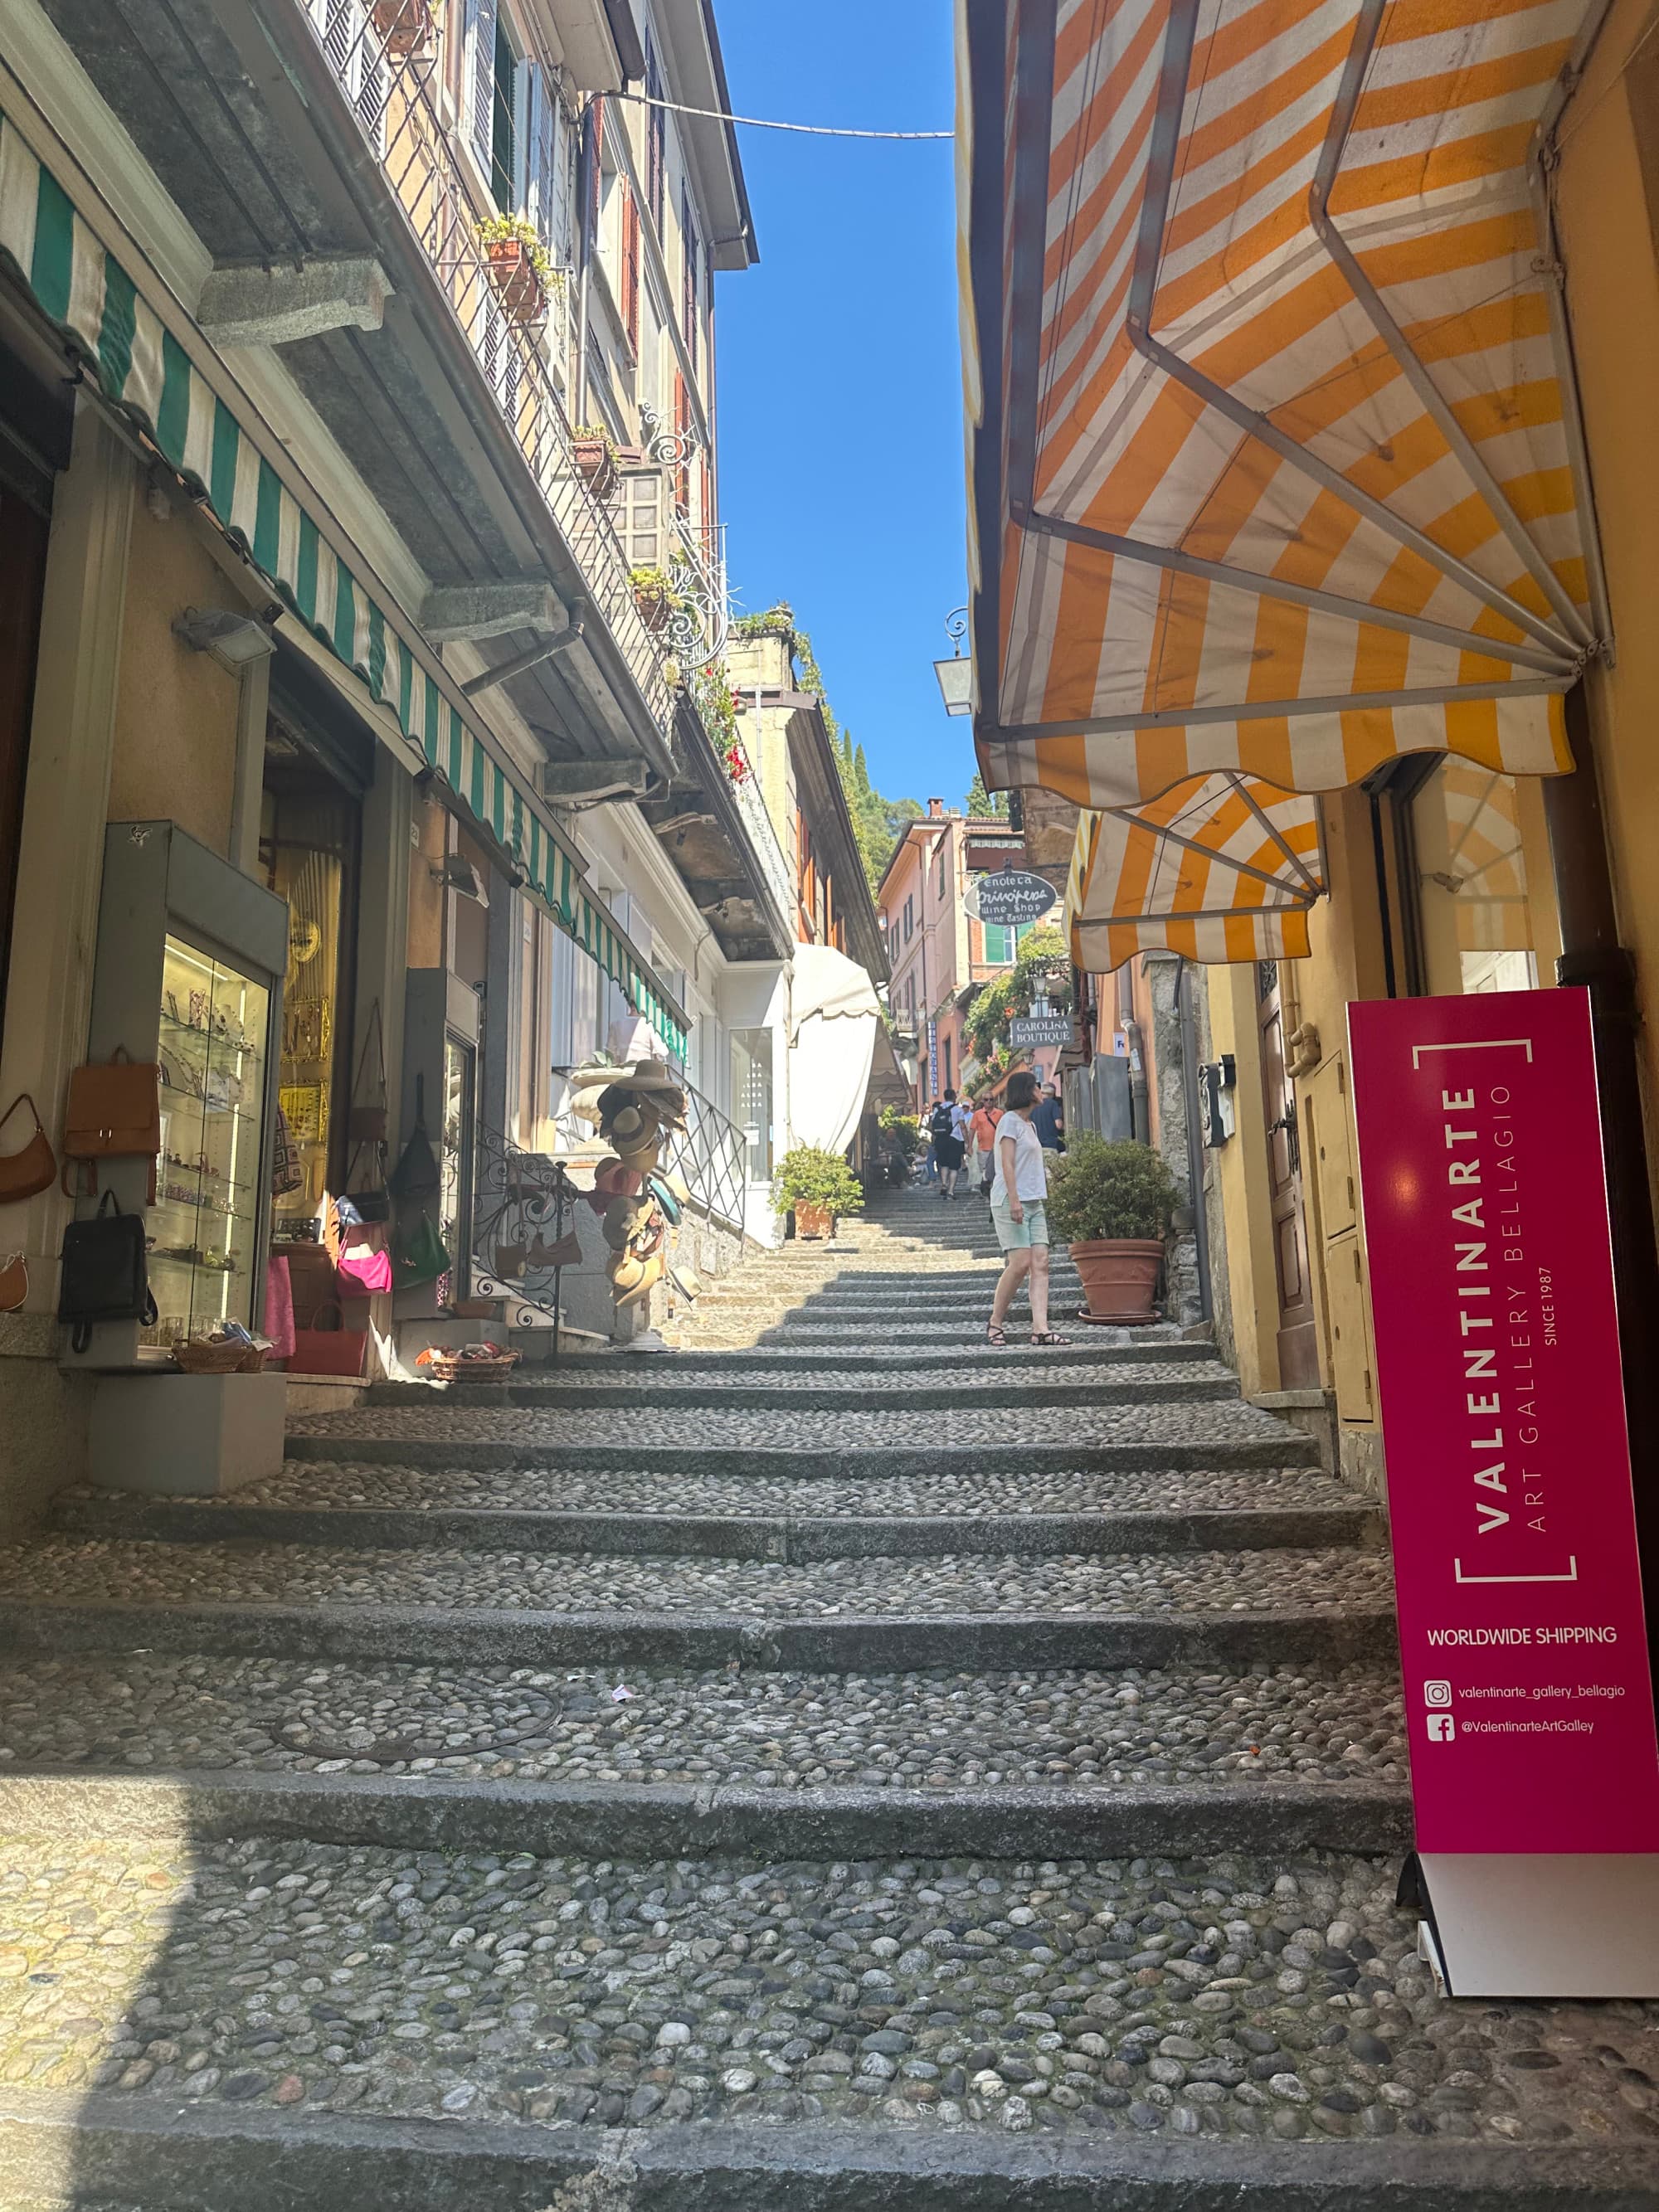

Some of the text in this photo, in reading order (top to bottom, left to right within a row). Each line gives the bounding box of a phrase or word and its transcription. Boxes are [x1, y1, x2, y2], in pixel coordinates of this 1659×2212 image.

[1014, 902, 1041, 912] Shop
[1016, 1020, 1068, 1032] CAROLINA
[1017, 1031, 1070, 1043] BOUTIQUE
[1442, 1088, 1510, 1534] VALENTINARTE
[1490, 1087, 1547, 1533] ART GALLERY BELLAGIO
[1539, 1266, 1557, 1345] SINCE 1987
[1427, 1626, 1618, 1646] WORLDWIDE SHIPPING
[1458, 1685, 1626, 1700] valentinarte_gallery_bellagio
[1462, 1719, 1594, 1734] @ValentinarteArtGalley
